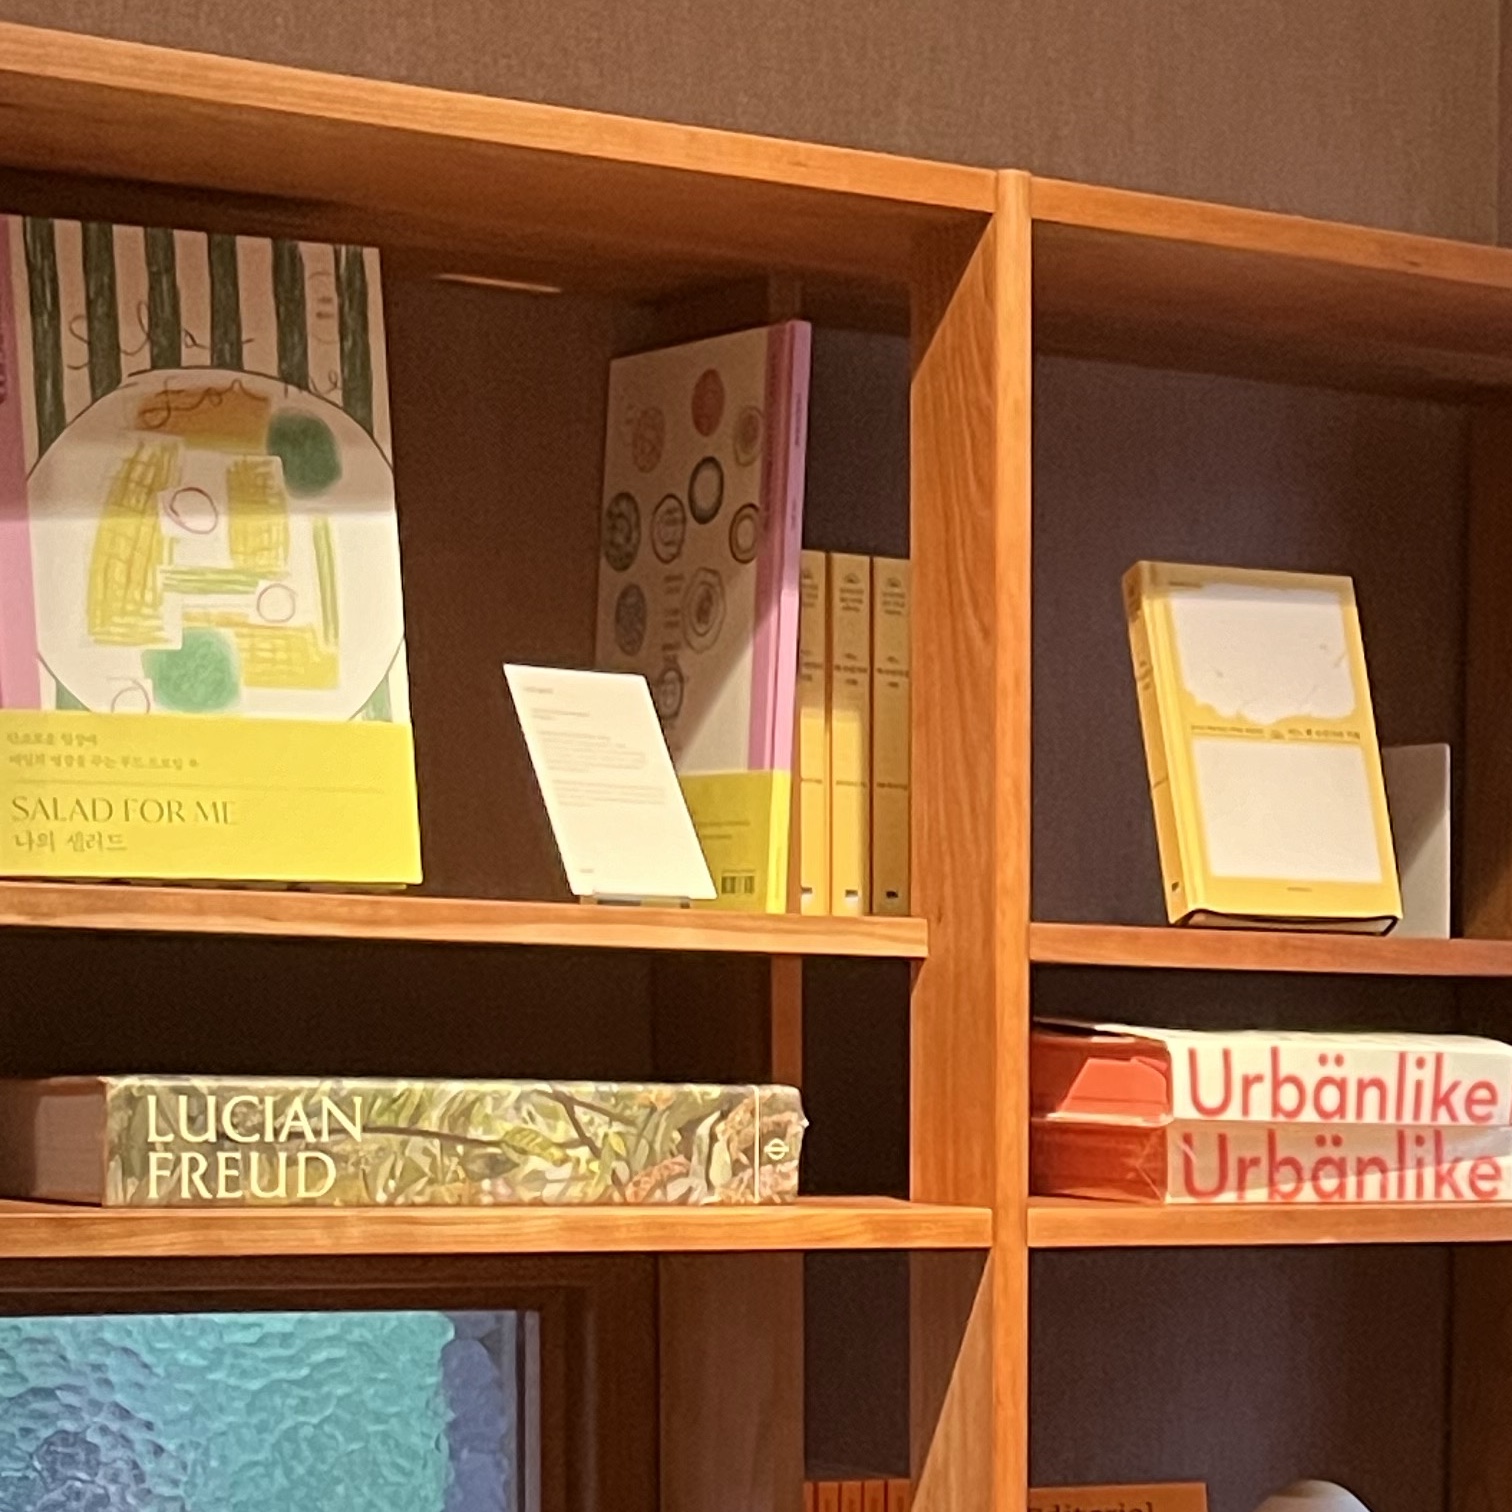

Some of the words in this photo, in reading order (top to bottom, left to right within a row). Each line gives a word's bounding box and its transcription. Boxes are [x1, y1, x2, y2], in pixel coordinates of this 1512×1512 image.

[11, 796, 114, 823] SALAD
[124, 798, 186, 824] FOR
[194, 800, 239, 825] ME
[14, 829, 56, 852] 나의
[67, 831, 128, 853] 샐러드
[1187, 1046, 1499, 1124] Urbänlike
[147, 1095, 363, 1143] LUCIAN
[147, 1151, 337, 1199] FREUD
[1182, 1127, 1502, 1201] Urbänlike
